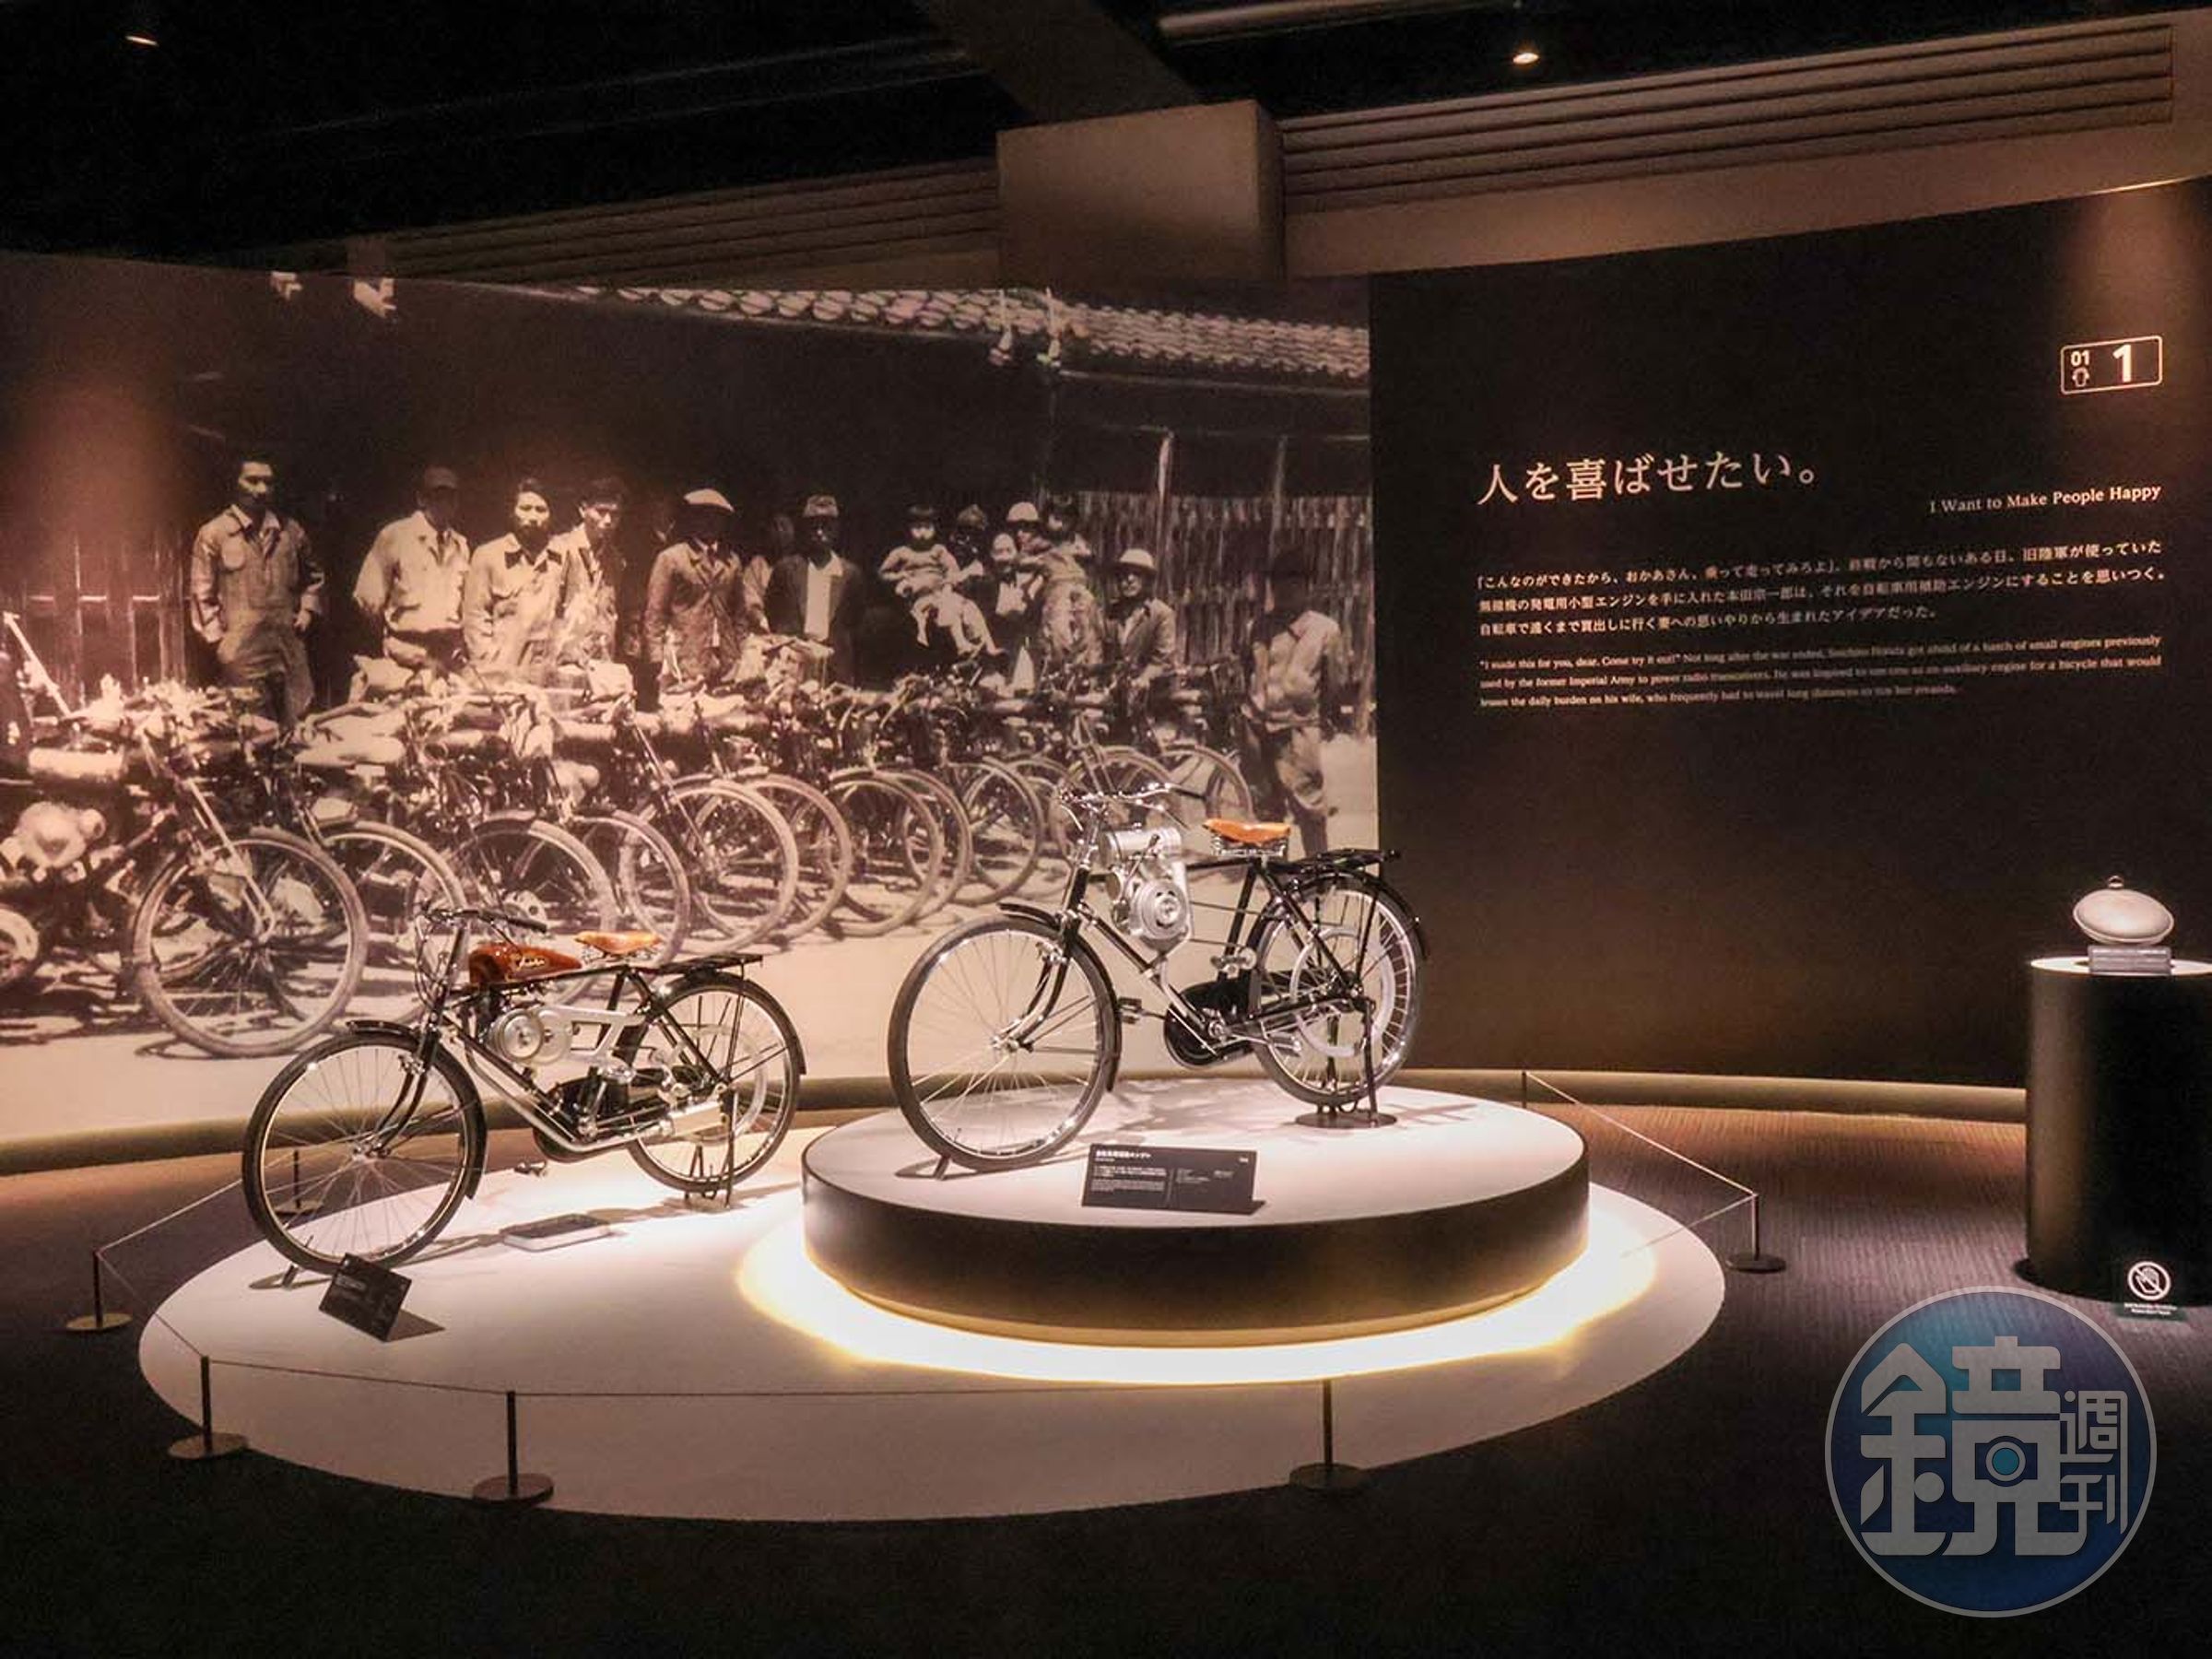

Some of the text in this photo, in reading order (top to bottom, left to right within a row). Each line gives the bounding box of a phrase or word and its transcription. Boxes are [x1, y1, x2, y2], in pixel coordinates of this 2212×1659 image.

[2071, 344, 2132, 382] 01 1
[1477, 451, 1815, 506] 人を喜ばせたい。
[1930, 485, 2162, 513] I Want to Make People Happy
